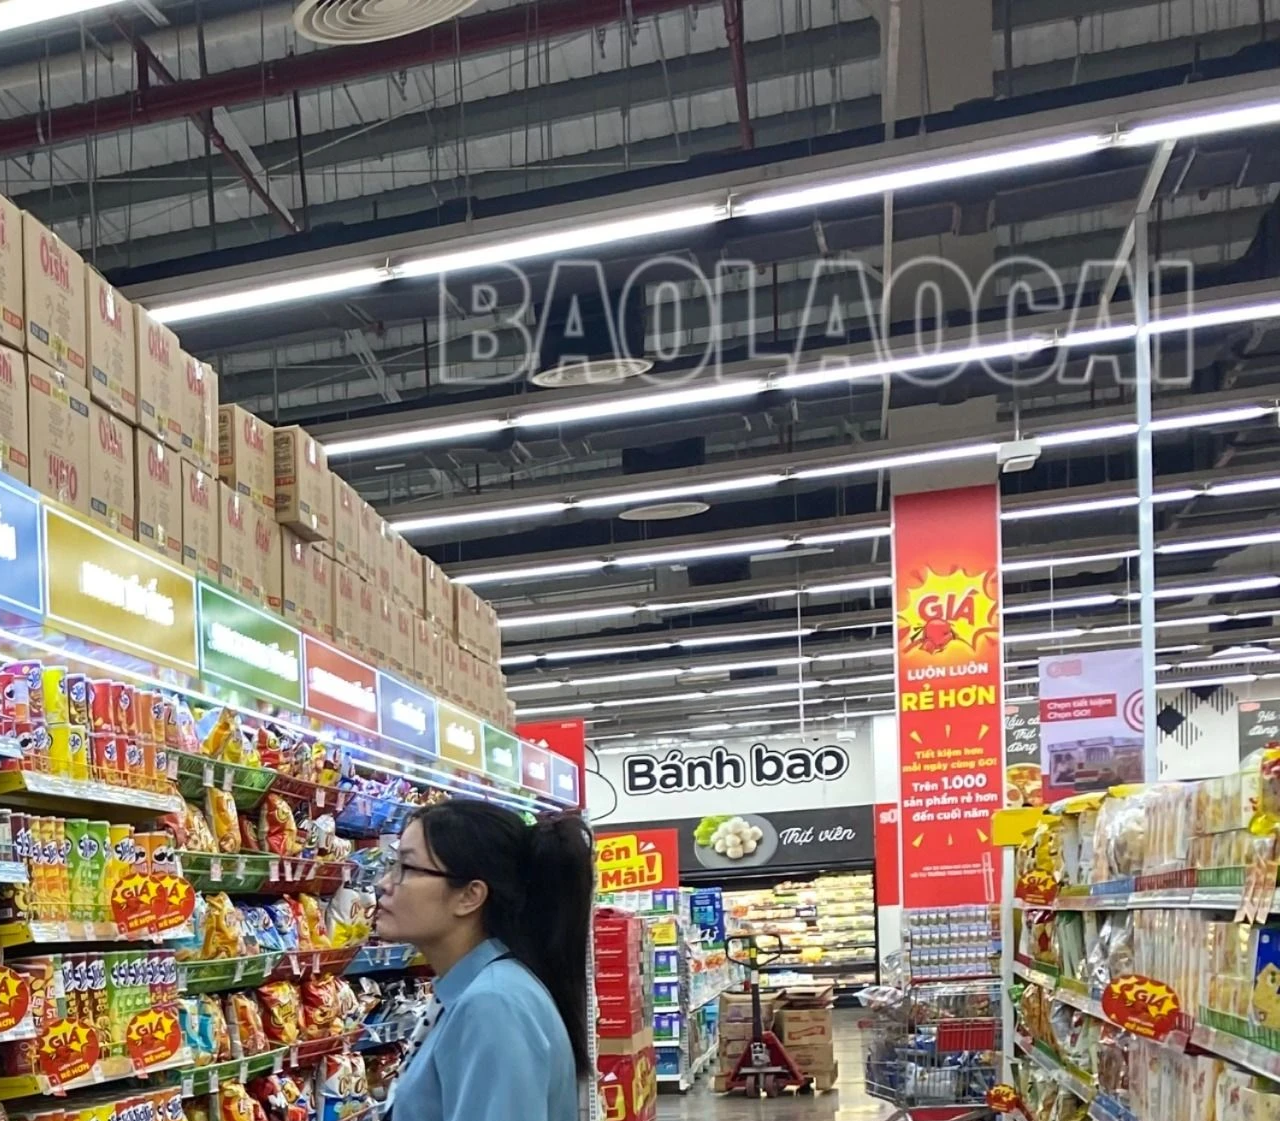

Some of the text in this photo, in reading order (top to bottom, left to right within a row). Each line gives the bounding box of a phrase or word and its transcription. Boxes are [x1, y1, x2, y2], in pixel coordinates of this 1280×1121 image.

[918, 586, 977, 626] GIÁ
[907, 660, 988, 682] LUÔN LUÔN
[902, 683, 996, 713] RẺ HƠN
[626, 744, 846, 793] Bánh bao
[912, 773, 988, 793] Trên 1.000
[903, 791, 999, 809] sản phẩm rẻ hơn
[912, 807, 990, 823] đến cuối năm
[780, 825, 857, 846] Thịt viên
[49, 1027, 80, 1046] GIÁ
